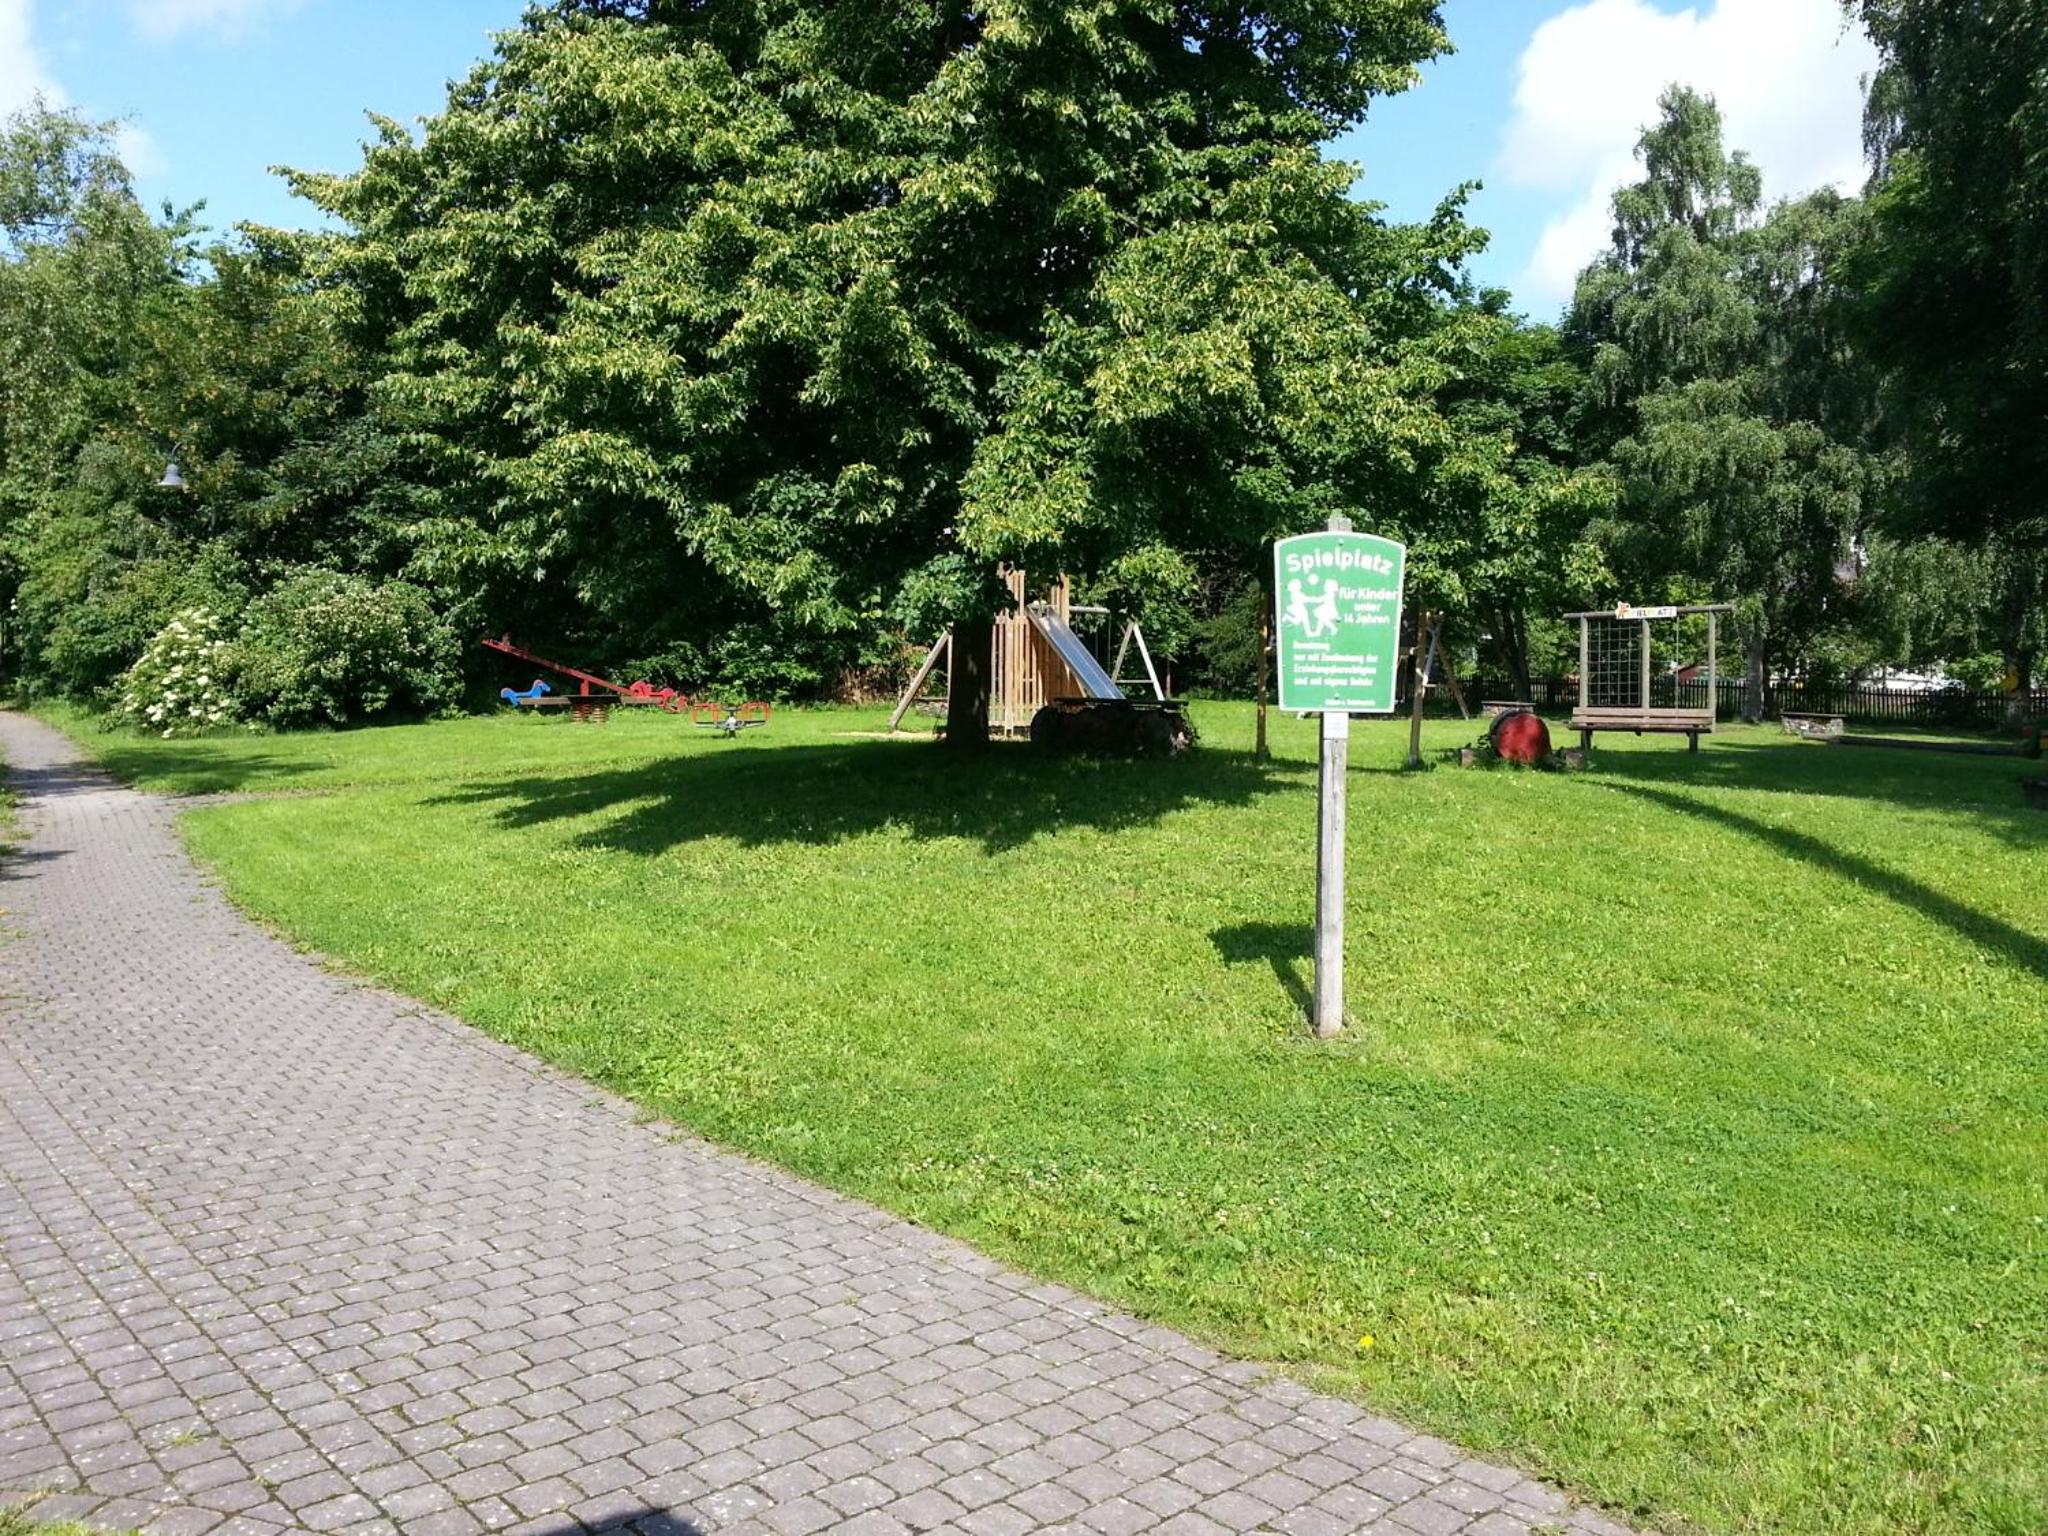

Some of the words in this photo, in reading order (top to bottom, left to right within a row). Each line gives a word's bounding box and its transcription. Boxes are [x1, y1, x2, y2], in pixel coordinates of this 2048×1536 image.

[1287, 548, 1392, 575] Spielplatz
[1340, 587, 1357, 599] für
[1359, 588, 1398, 600] Kinder
